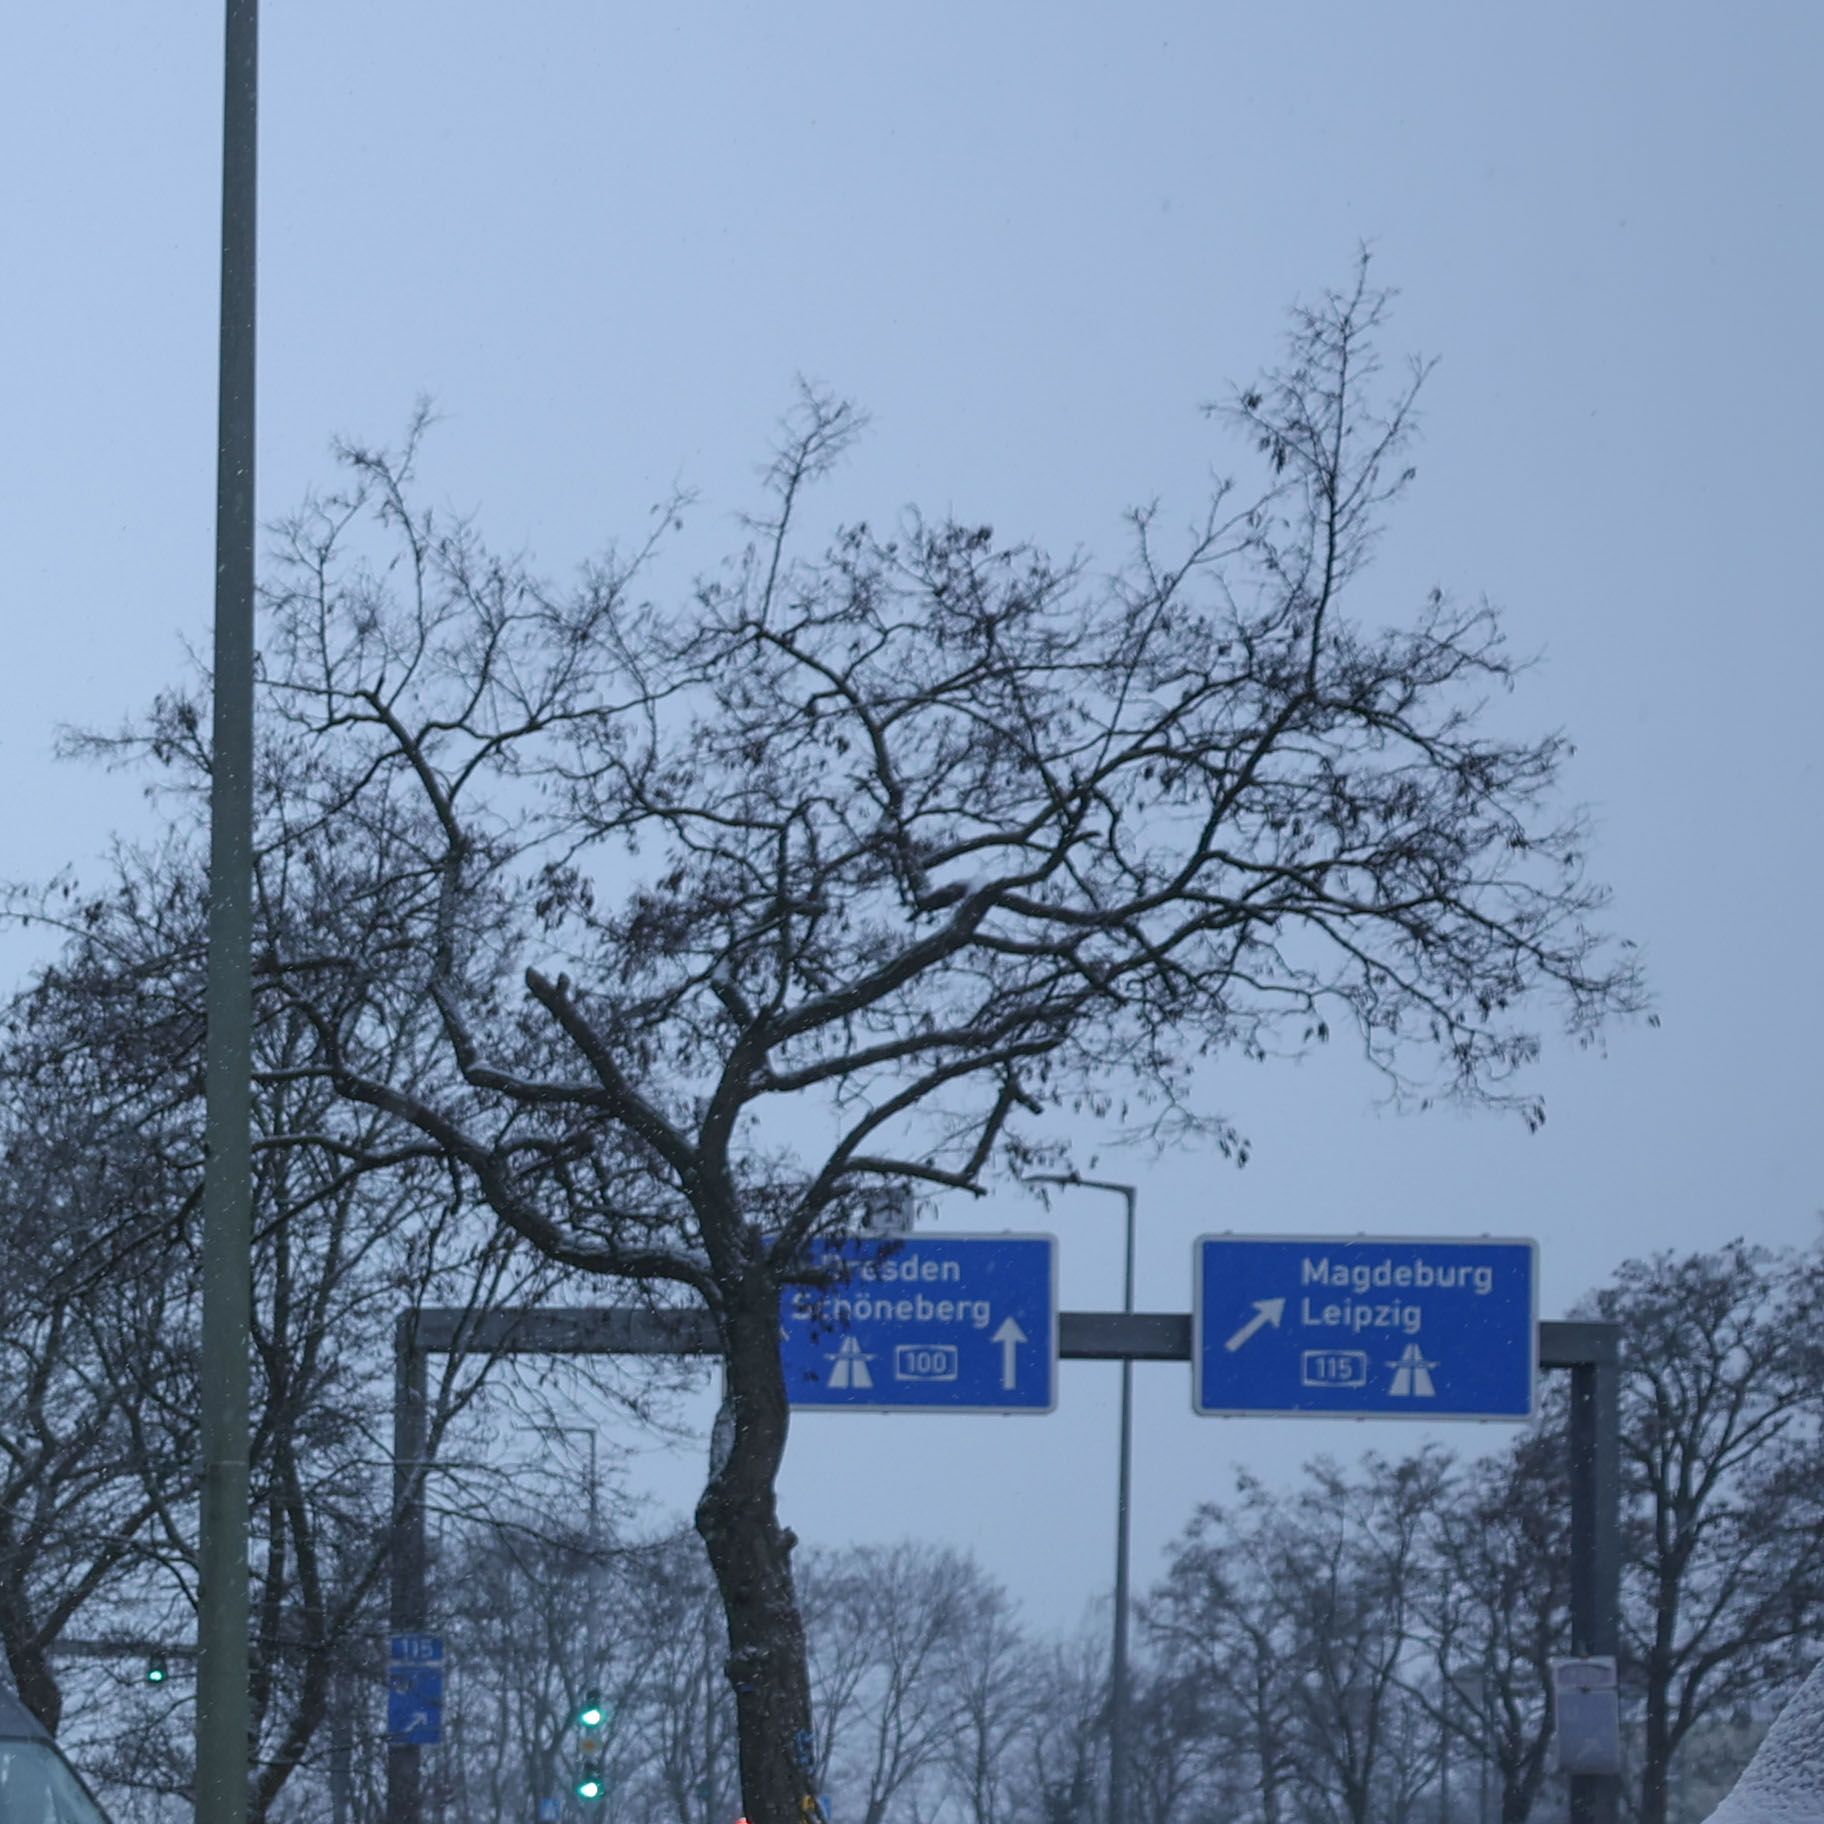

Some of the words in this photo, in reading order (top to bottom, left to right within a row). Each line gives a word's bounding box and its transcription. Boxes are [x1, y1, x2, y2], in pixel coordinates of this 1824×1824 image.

[1302, 1257, 1493, 1295] Magdeburg
[1302, 1298, 1422, 1334] Leipzig
[906, 1351, 948, 1375] 100
[1316, 1356, 1353, 1380] 115
[401, 1639, 433, 1660] 115
